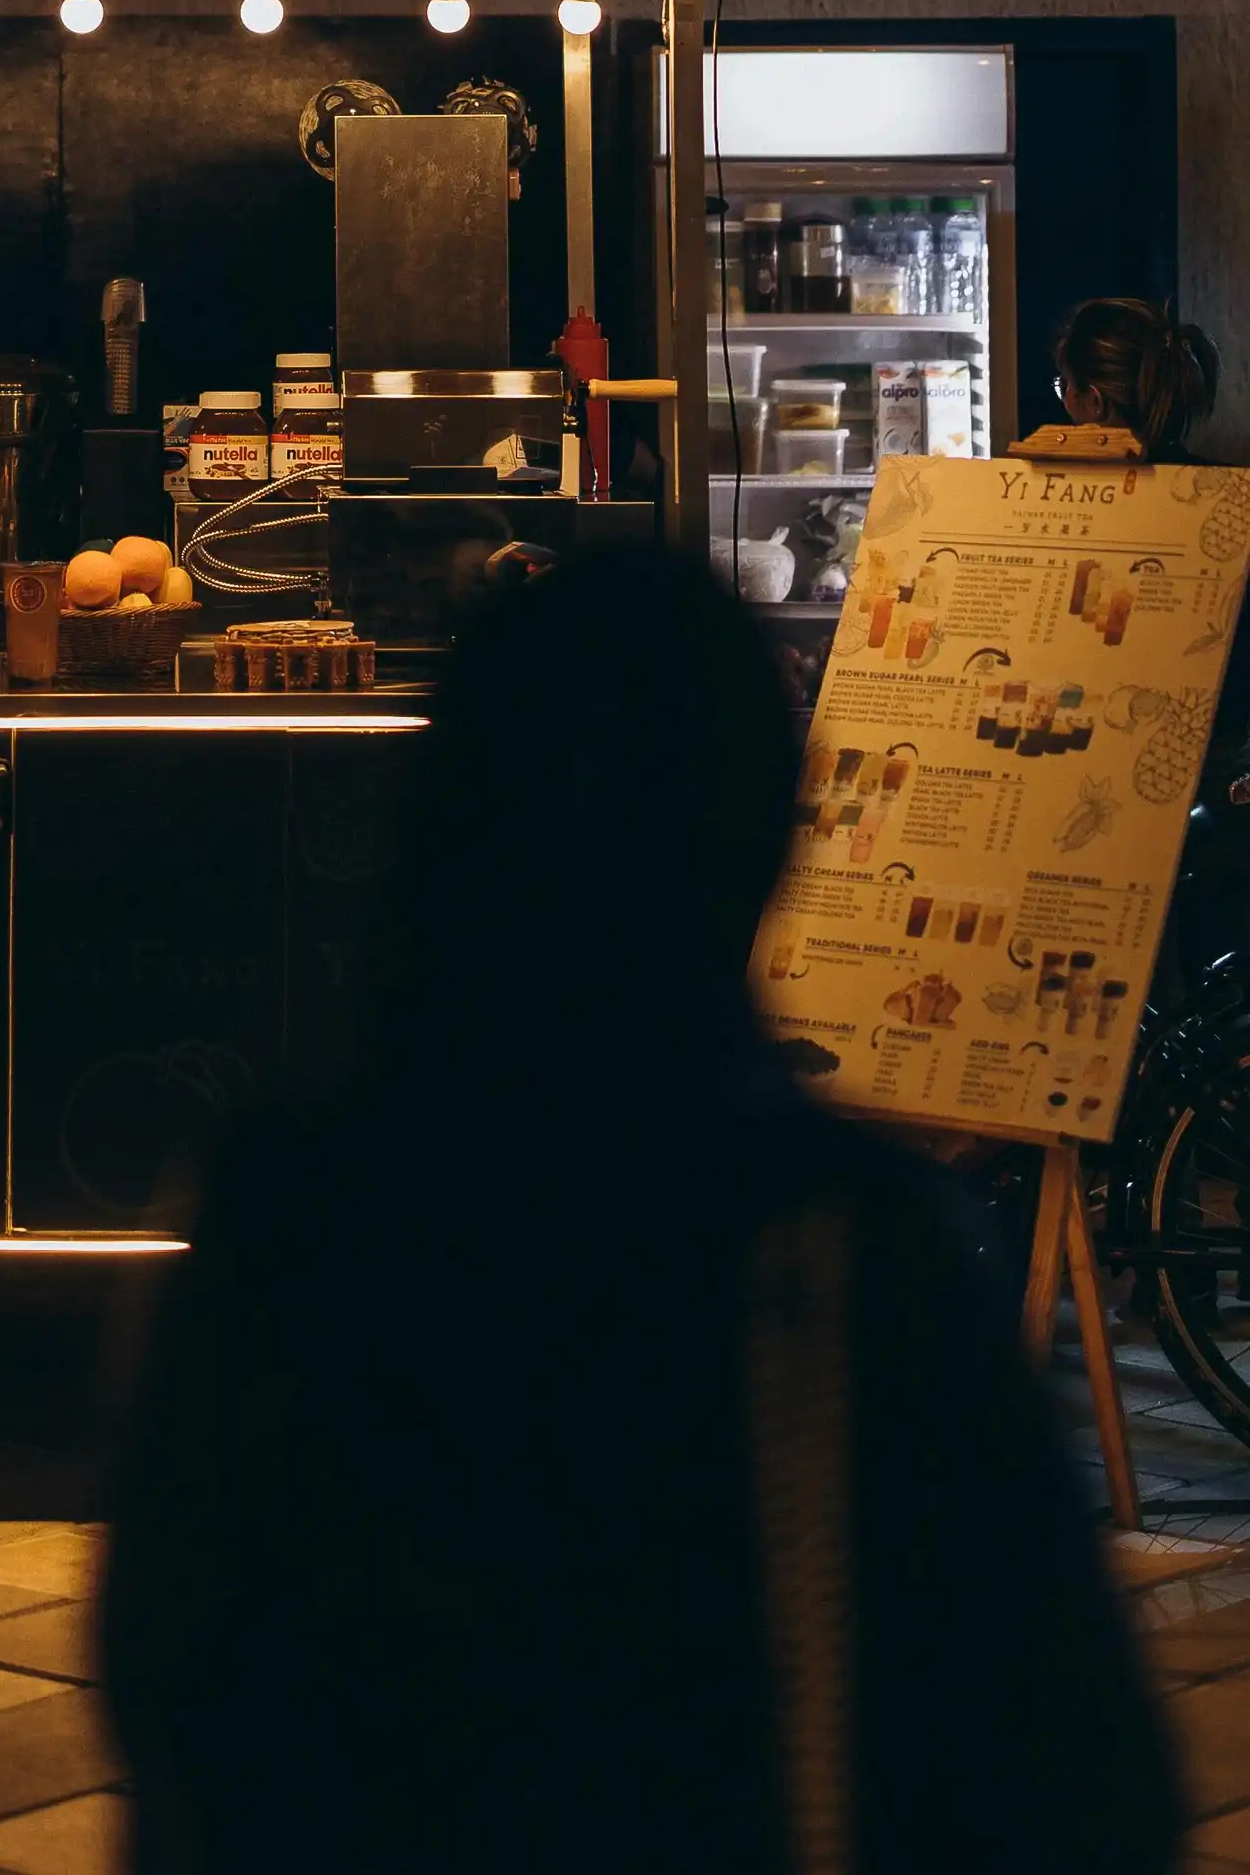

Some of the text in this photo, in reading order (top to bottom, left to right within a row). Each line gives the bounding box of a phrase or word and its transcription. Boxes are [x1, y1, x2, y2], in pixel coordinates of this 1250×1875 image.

[882, 384, 919, 402] alpro
[203, 446, 258, 461] nutella
[286, 446, 342, 461] nutella
[999, 471, 1028, 500] YI
[1040, 472, 1120, 505] FANG
[960, 553, 985, 561] FRUIT
[987, 554, 1003, 562] TEA
[1005, 556, 1034, 564] SERIES
[1143, 564, 1160, 573] TEA
[834, 669, 867, 678] BROWN
[867, 671, 897, 680] SUGAR
[897, 673, 924, 682] PEARL
[926, 675, 955, 684] SERIES
[959, 677, 967, 685] M
[916, 765, 934, 774] TEA
[934, 766, 961, 775] LATTE
[962, 768, 993, 778] SERIES
[814, 868, 844, 877] CREAM
[846, 871, 874, 880] SERIES
[806, 937, 860, 951] TRADITIONAL
